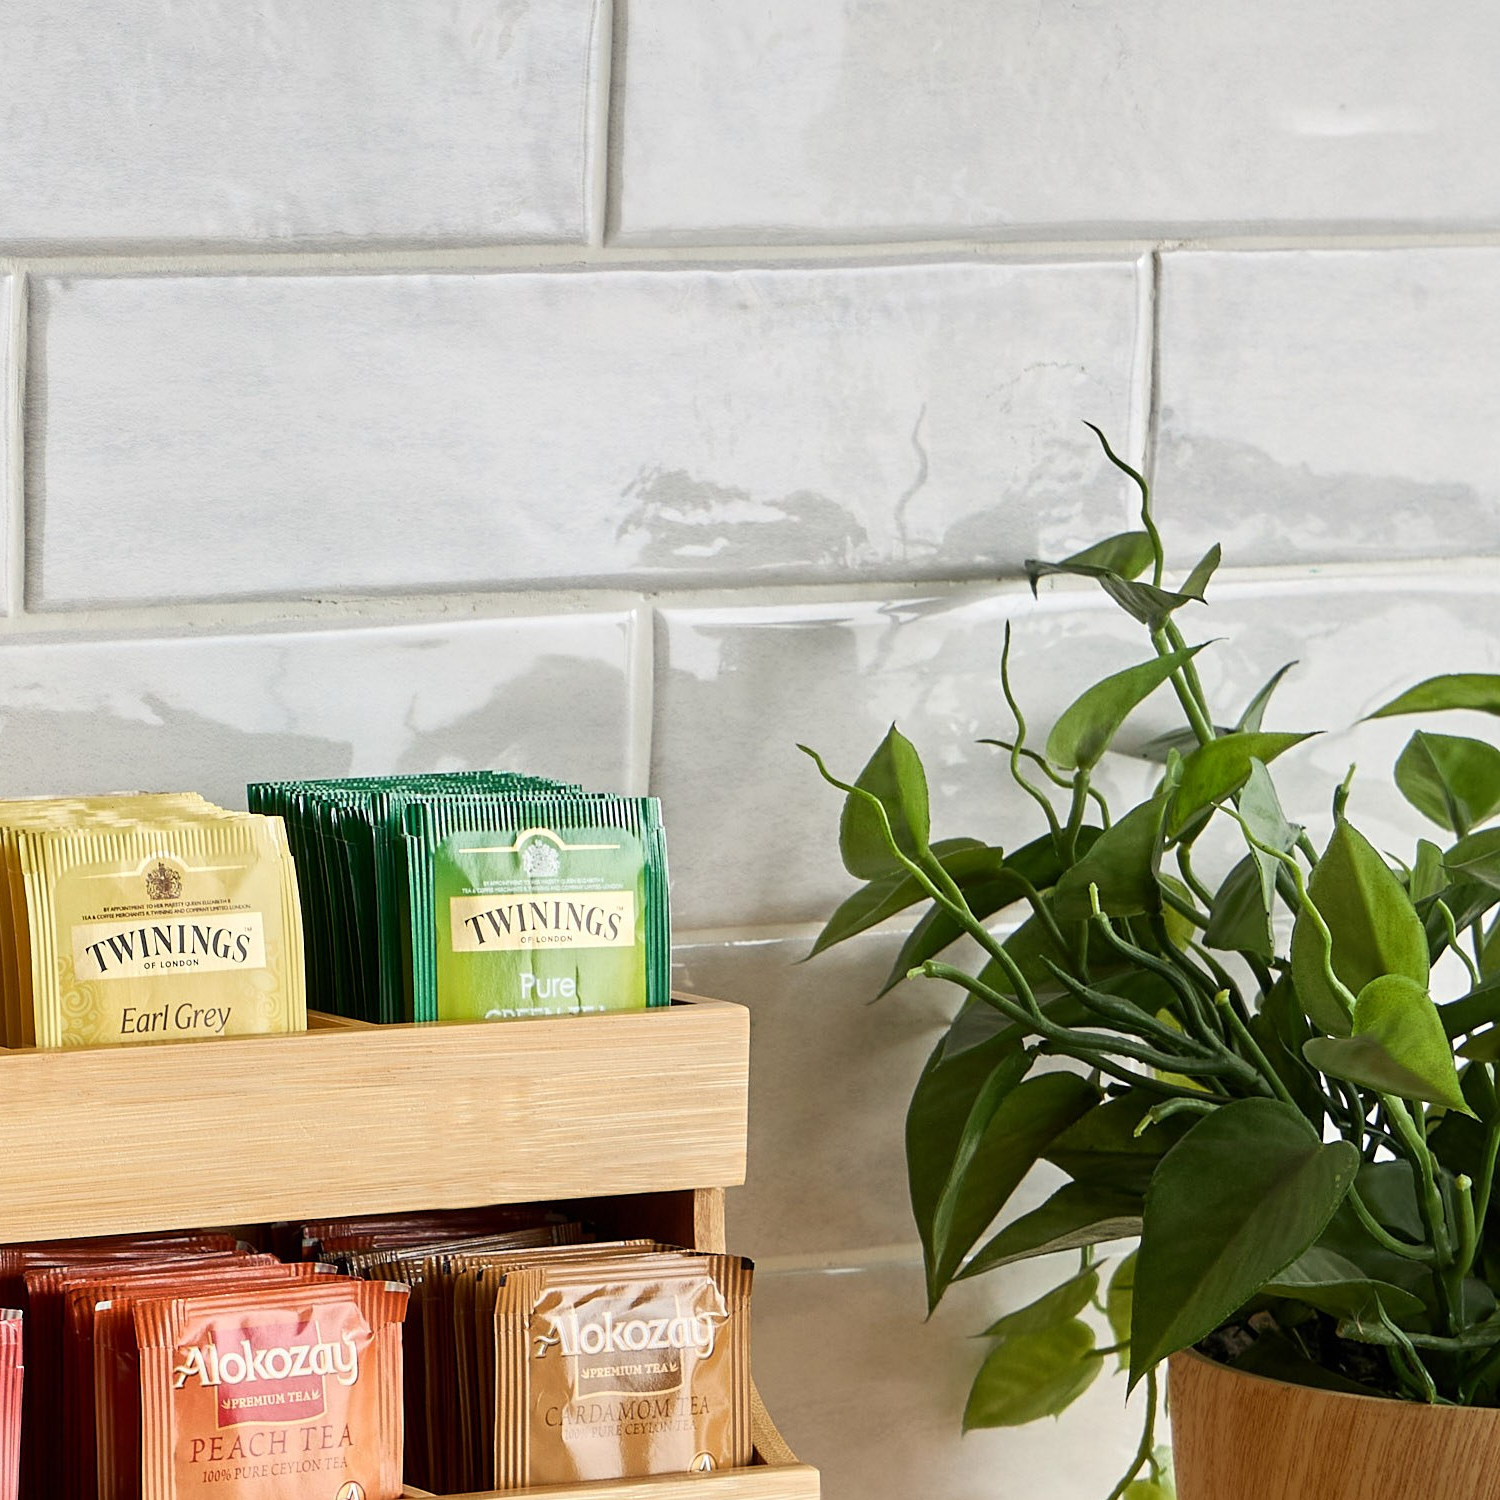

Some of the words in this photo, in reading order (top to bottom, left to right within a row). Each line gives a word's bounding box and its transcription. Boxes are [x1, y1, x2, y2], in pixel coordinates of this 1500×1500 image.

[520, 936, 531, 944] OF
[536, 935, 573, 943] LONDON
[144, 962, 156, 970] OF
[160, 959, 199, 968] LONDON
[518, 972, 575, 999] Pure
[120, 1004, 170, 1034] Earl
[174, 1002, 232, 1034] Grey
[534, 1312, 716, 1360] Alokozay
[173, 1332, 359, 1390] Alokozay
[589, 1364, 642, 1379] PREMIUM
[644, 1362, 670, 1374] TEA
[231, 1394, 285, 1409] PREMIUM
[287, 1391, 311, 1403] TEA
[545, 1399, 673, 1427] CARDAMOM
[677, 1395, 710, 1417] TEA
[624, 1421, 672, 1435] CEYLON
[674, 1419, 697, 1431] TEA
[189, 1429, 287, 1464] PEACH
[300, 1424, 354, 1452] TEA
[202, 1470, 231, 1484] 100%
[234, 1464, 268, 1480] PURE
[270, 1459, 322, 1477] CEYLON
[324, 1456, 348, 1471] TEA
